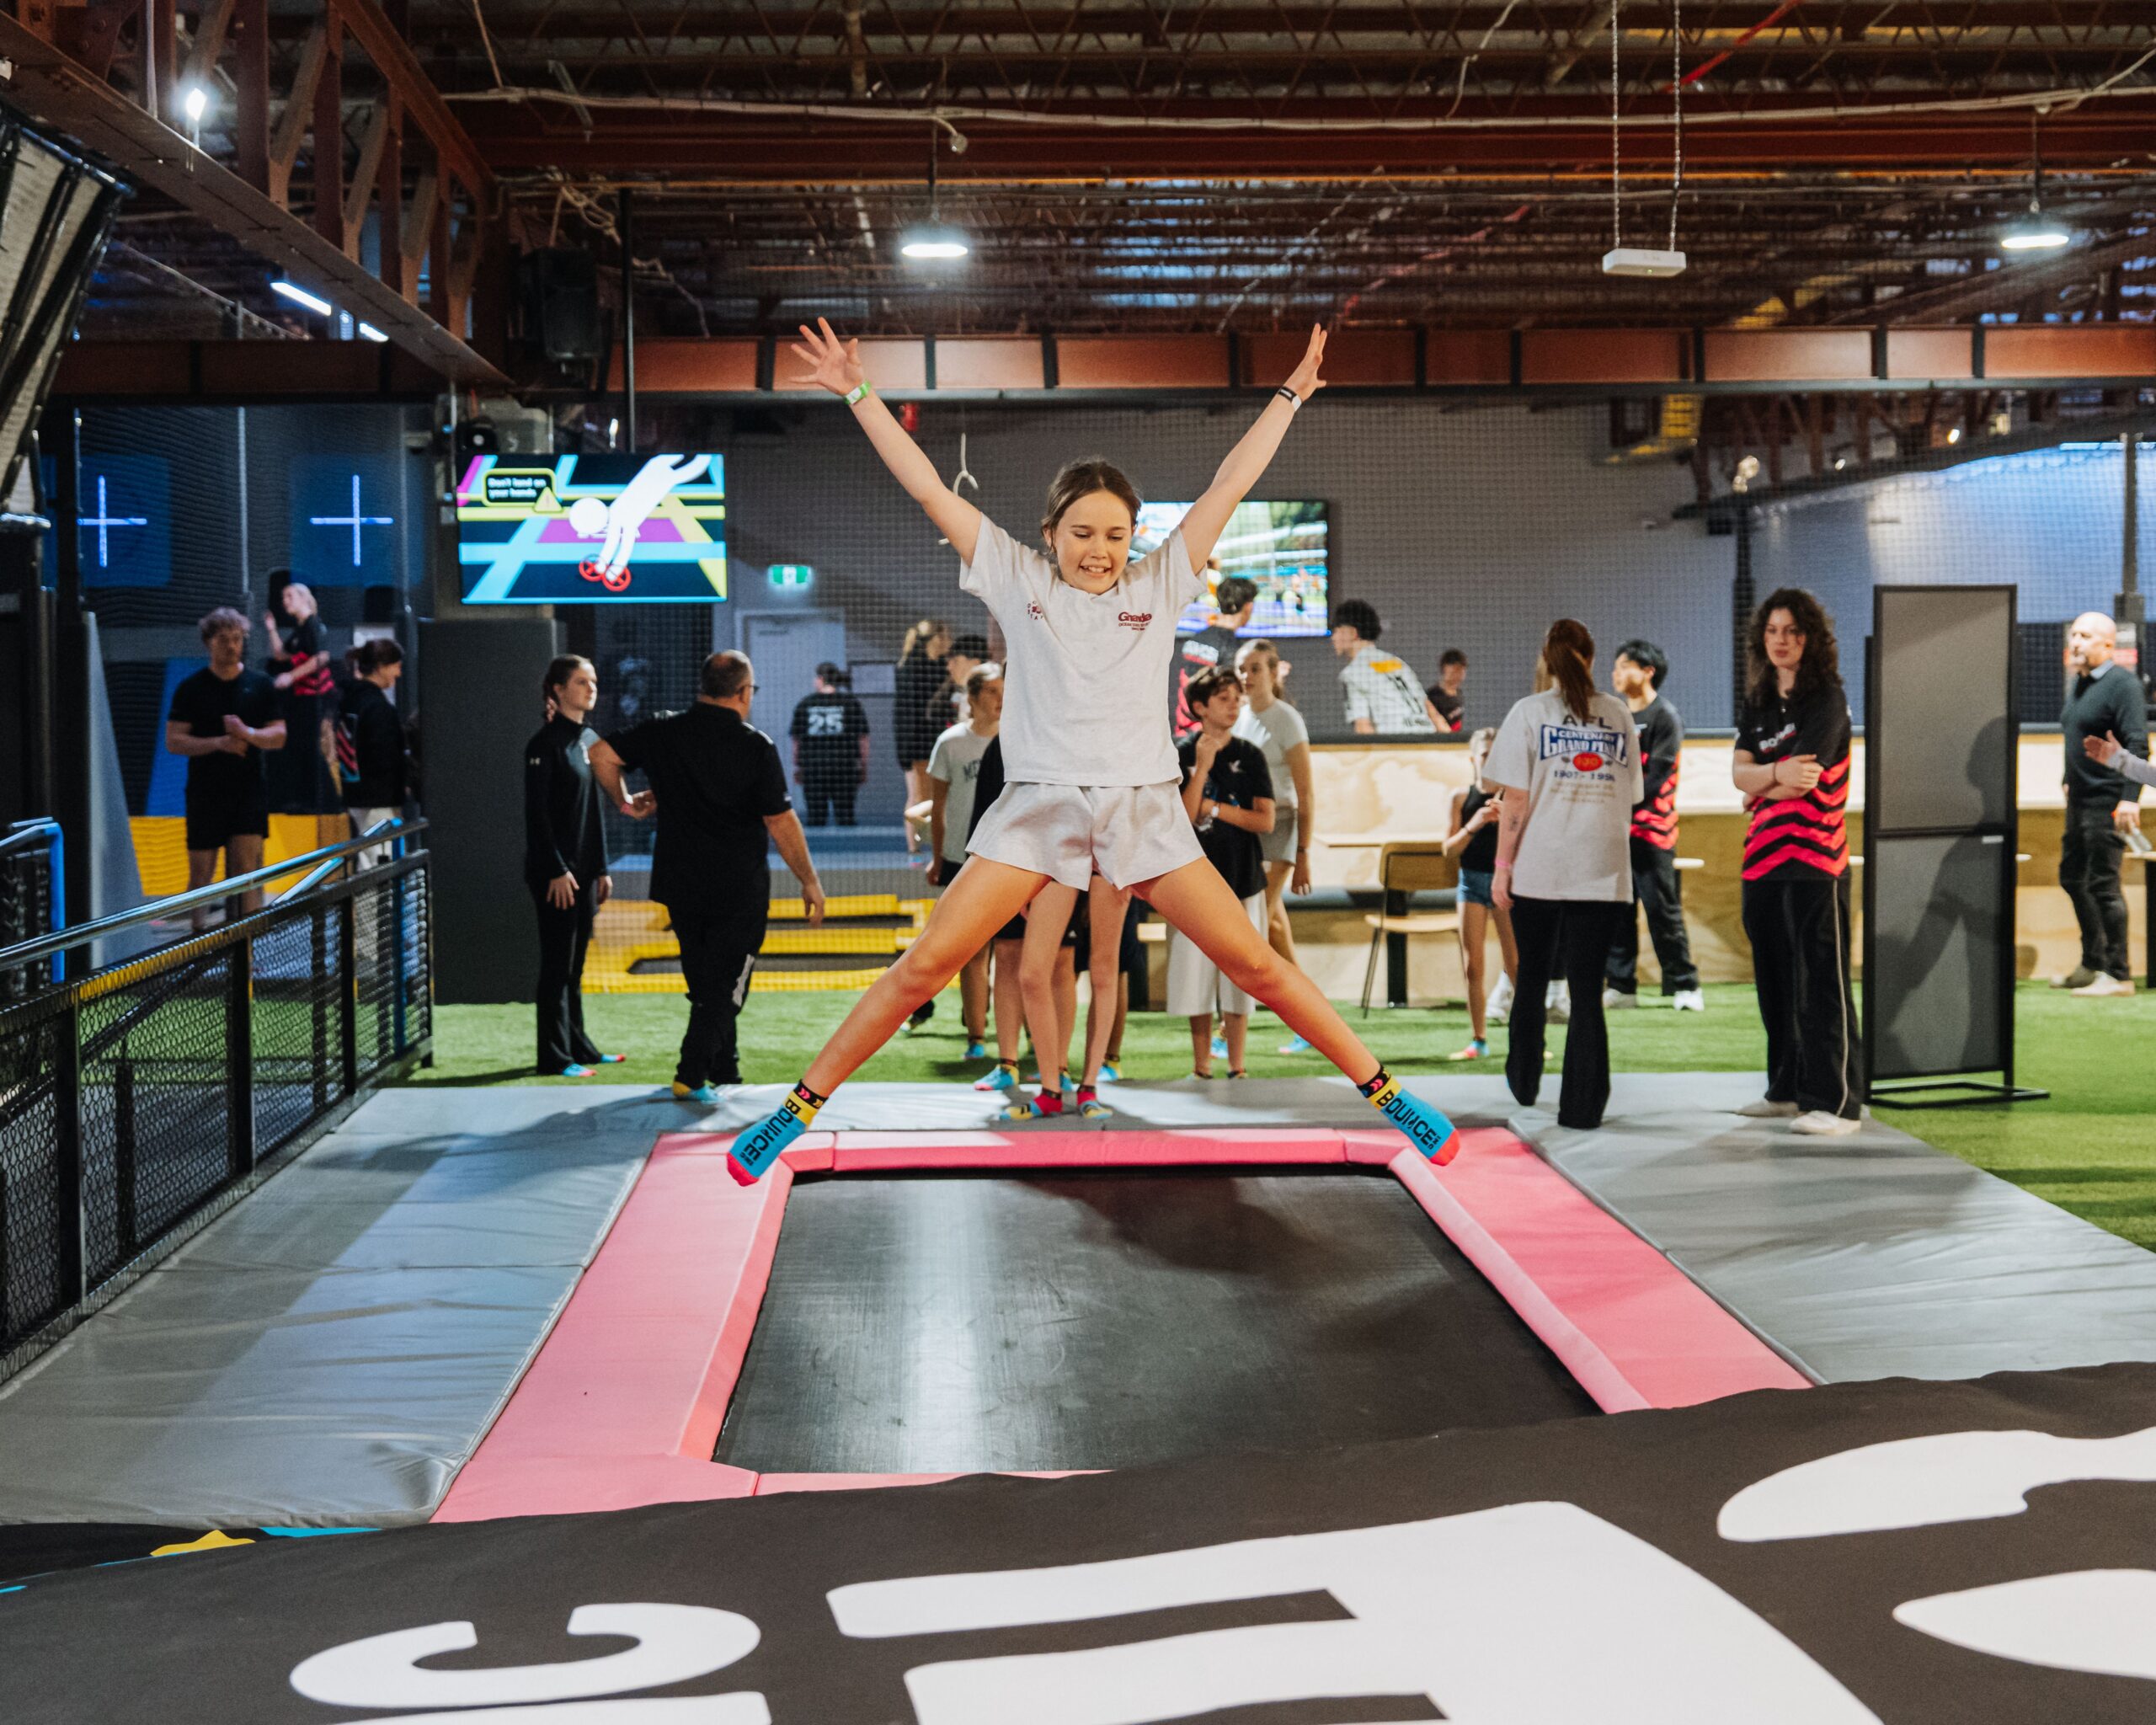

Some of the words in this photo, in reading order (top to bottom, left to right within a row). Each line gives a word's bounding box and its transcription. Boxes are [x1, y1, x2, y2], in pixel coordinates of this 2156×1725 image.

[808, 713, 842, 734] 25
[1562, 715, 1612, 729] AFL
[1543, 726, 1589, 757] GRAND
[744, 1099, 802, 1162] BOUNCE
[1376, 1090, 1437, 1146] BOUNCE
